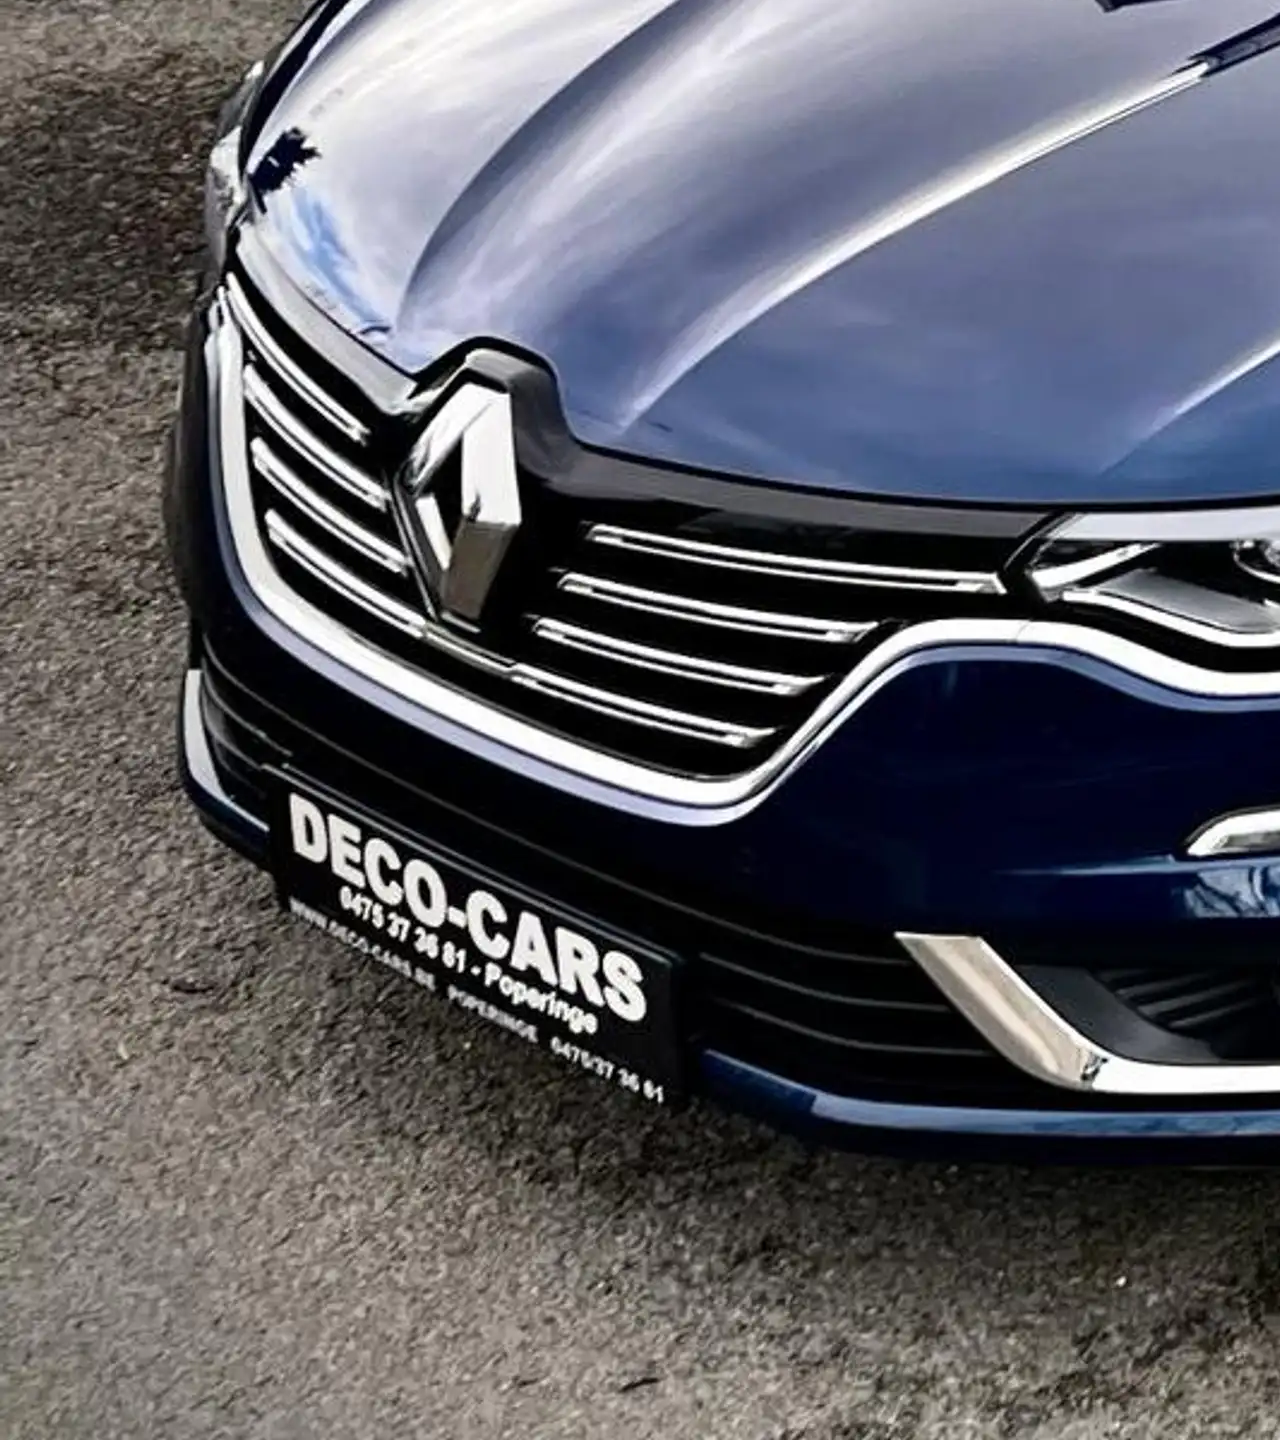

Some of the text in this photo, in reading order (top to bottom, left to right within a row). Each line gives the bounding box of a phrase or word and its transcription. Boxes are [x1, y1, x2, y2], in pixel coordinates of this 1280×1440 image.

[289, 793, 648, 1021] DECO-CARS
[339, 886, 385, 929] 0475
[388, 912, 411, 942] 37
[442, 941, 466, 973] 81
[484, 962, 598, 1034] Poperinge
